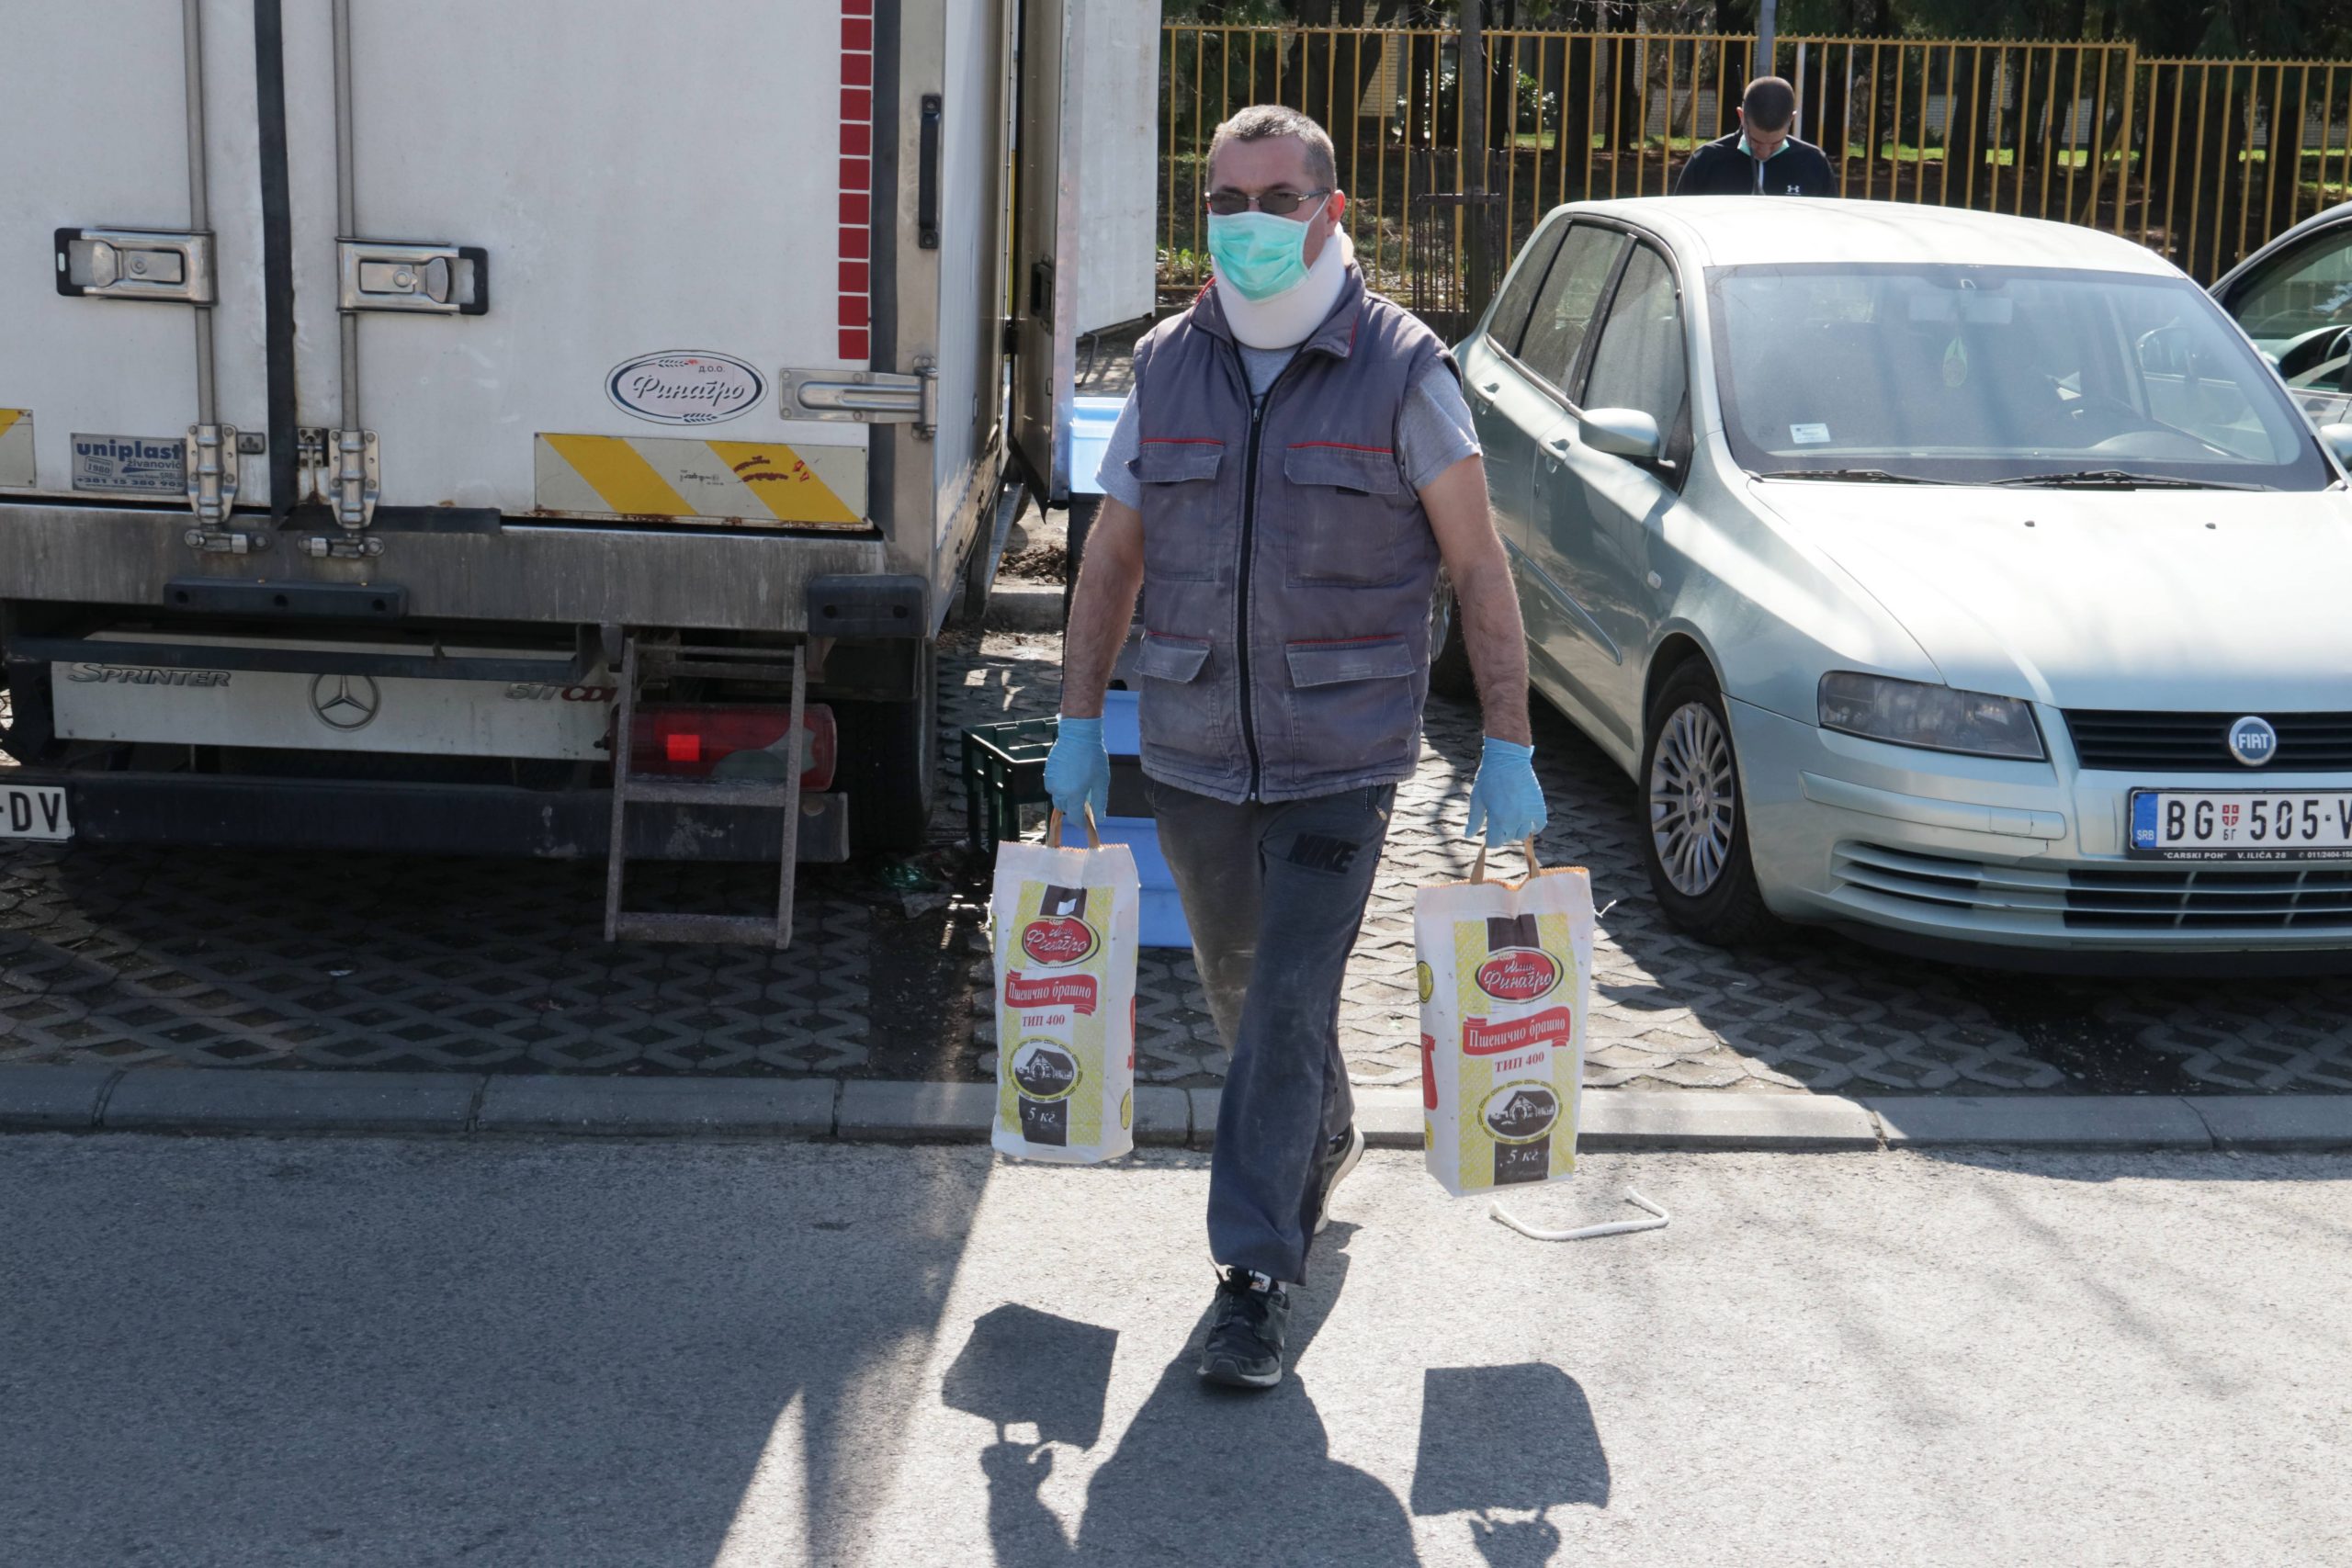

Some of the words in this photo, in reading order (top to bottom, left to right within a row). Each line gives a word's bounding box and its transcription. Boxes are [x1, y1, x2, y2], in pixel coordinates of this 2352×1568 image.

[76, 439, 182, 462] uniplast
[2237, 733, 2269, 750] FIAT
[2166, 799, 2214, 840] BG
[2136, 829, 2154, 841] SRB
[1286, 832, 1361, 874] NIKE
[1009, 982, 1049, 1001] Пшенично
[1052, 981, 1091, 1001] брашно
[1022, 1015, 1044, 1027] ТИП
[1046, 1014, 1065, 1026] 400
[1469, 1027, 1526, 1047] Пшенично
[1529, 1016, 1566, 1040] брашно
[1495, 1057, 1522, 1073] ТИП
[1525, 1051, 1544, 1065] 400
[1027, 1107, 1036, 1121] 5
[1507, 1149, 1518, 1164] 5
